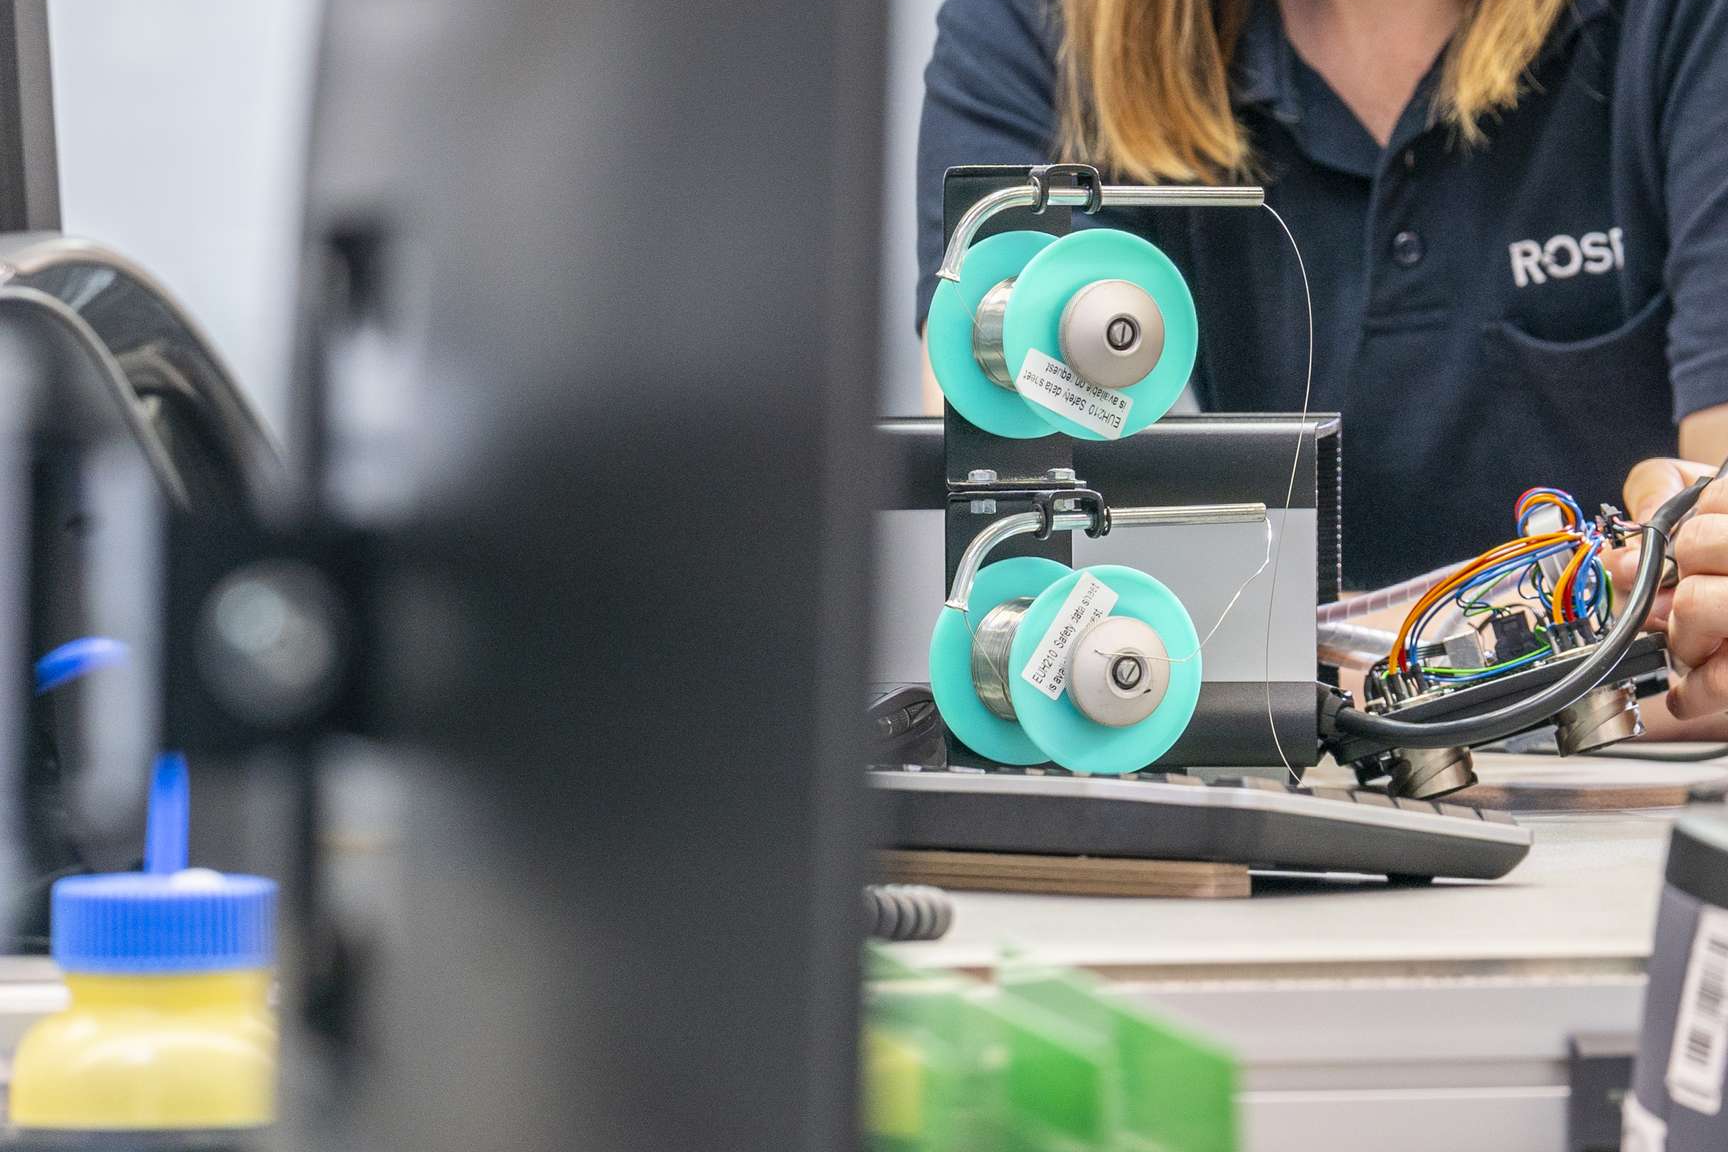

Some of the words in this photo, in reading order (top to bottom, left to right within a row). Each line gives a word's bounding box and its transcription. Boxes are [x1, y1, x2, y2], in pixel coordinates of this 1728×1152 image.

[1044, 380, 1062, 397] data
[1074, 378, 1086, 389] on
[1062, 388, 1087, 411] Safety
[1086, 384, 1119, 406] available
[1118, 400, 1128, 412] is
[1088, 404, 1122, 428] EUH210
[1032, 649, 1059, 685] EUH210
[1054, 624, 1078, 649] Safety
[1048, 683, 1058, 693] is
